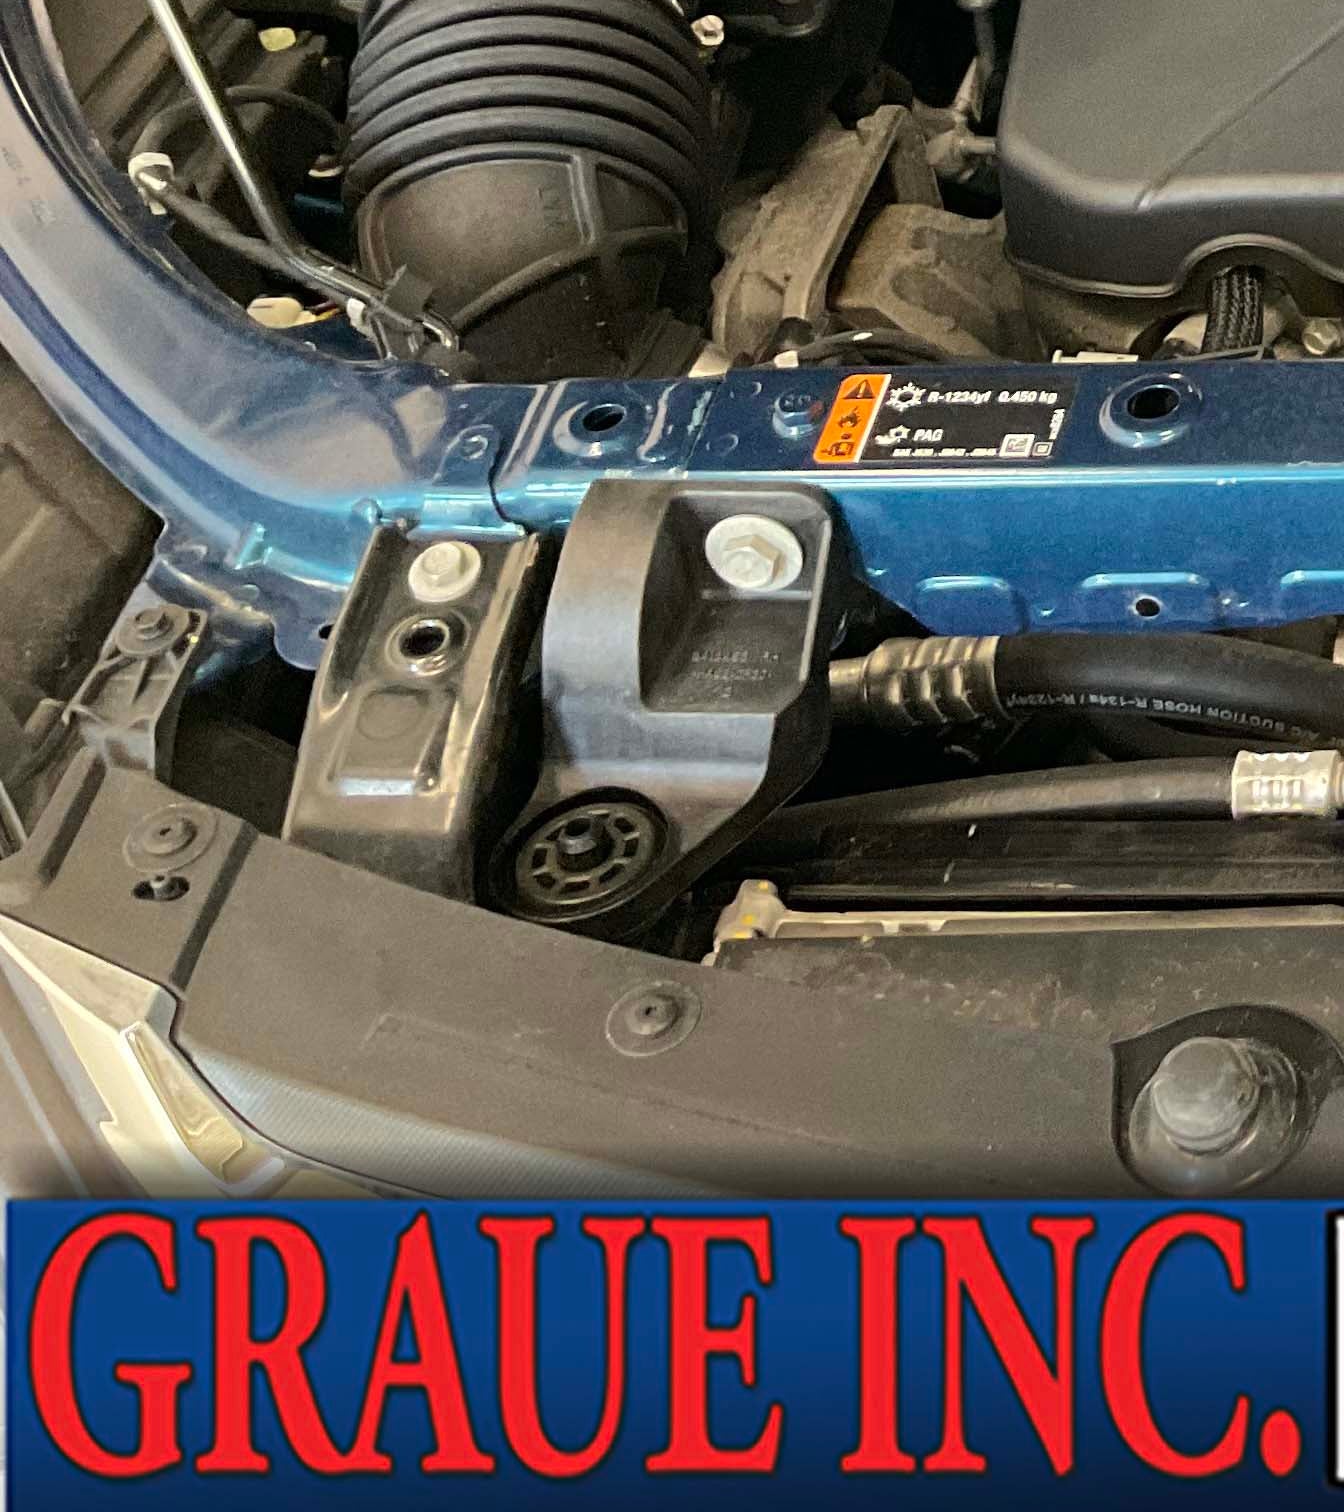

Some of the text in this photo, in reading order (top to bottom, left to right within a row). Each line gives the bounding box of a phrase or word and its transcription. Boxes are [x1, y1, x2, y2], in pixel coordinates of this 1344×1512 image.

[926, 390, 992, 405] R-1234yf
[1038, 390, 1059, 405] kg
[913, 428, 944, 442] PAG
[1151, 698, 1202, 715] HOSE
